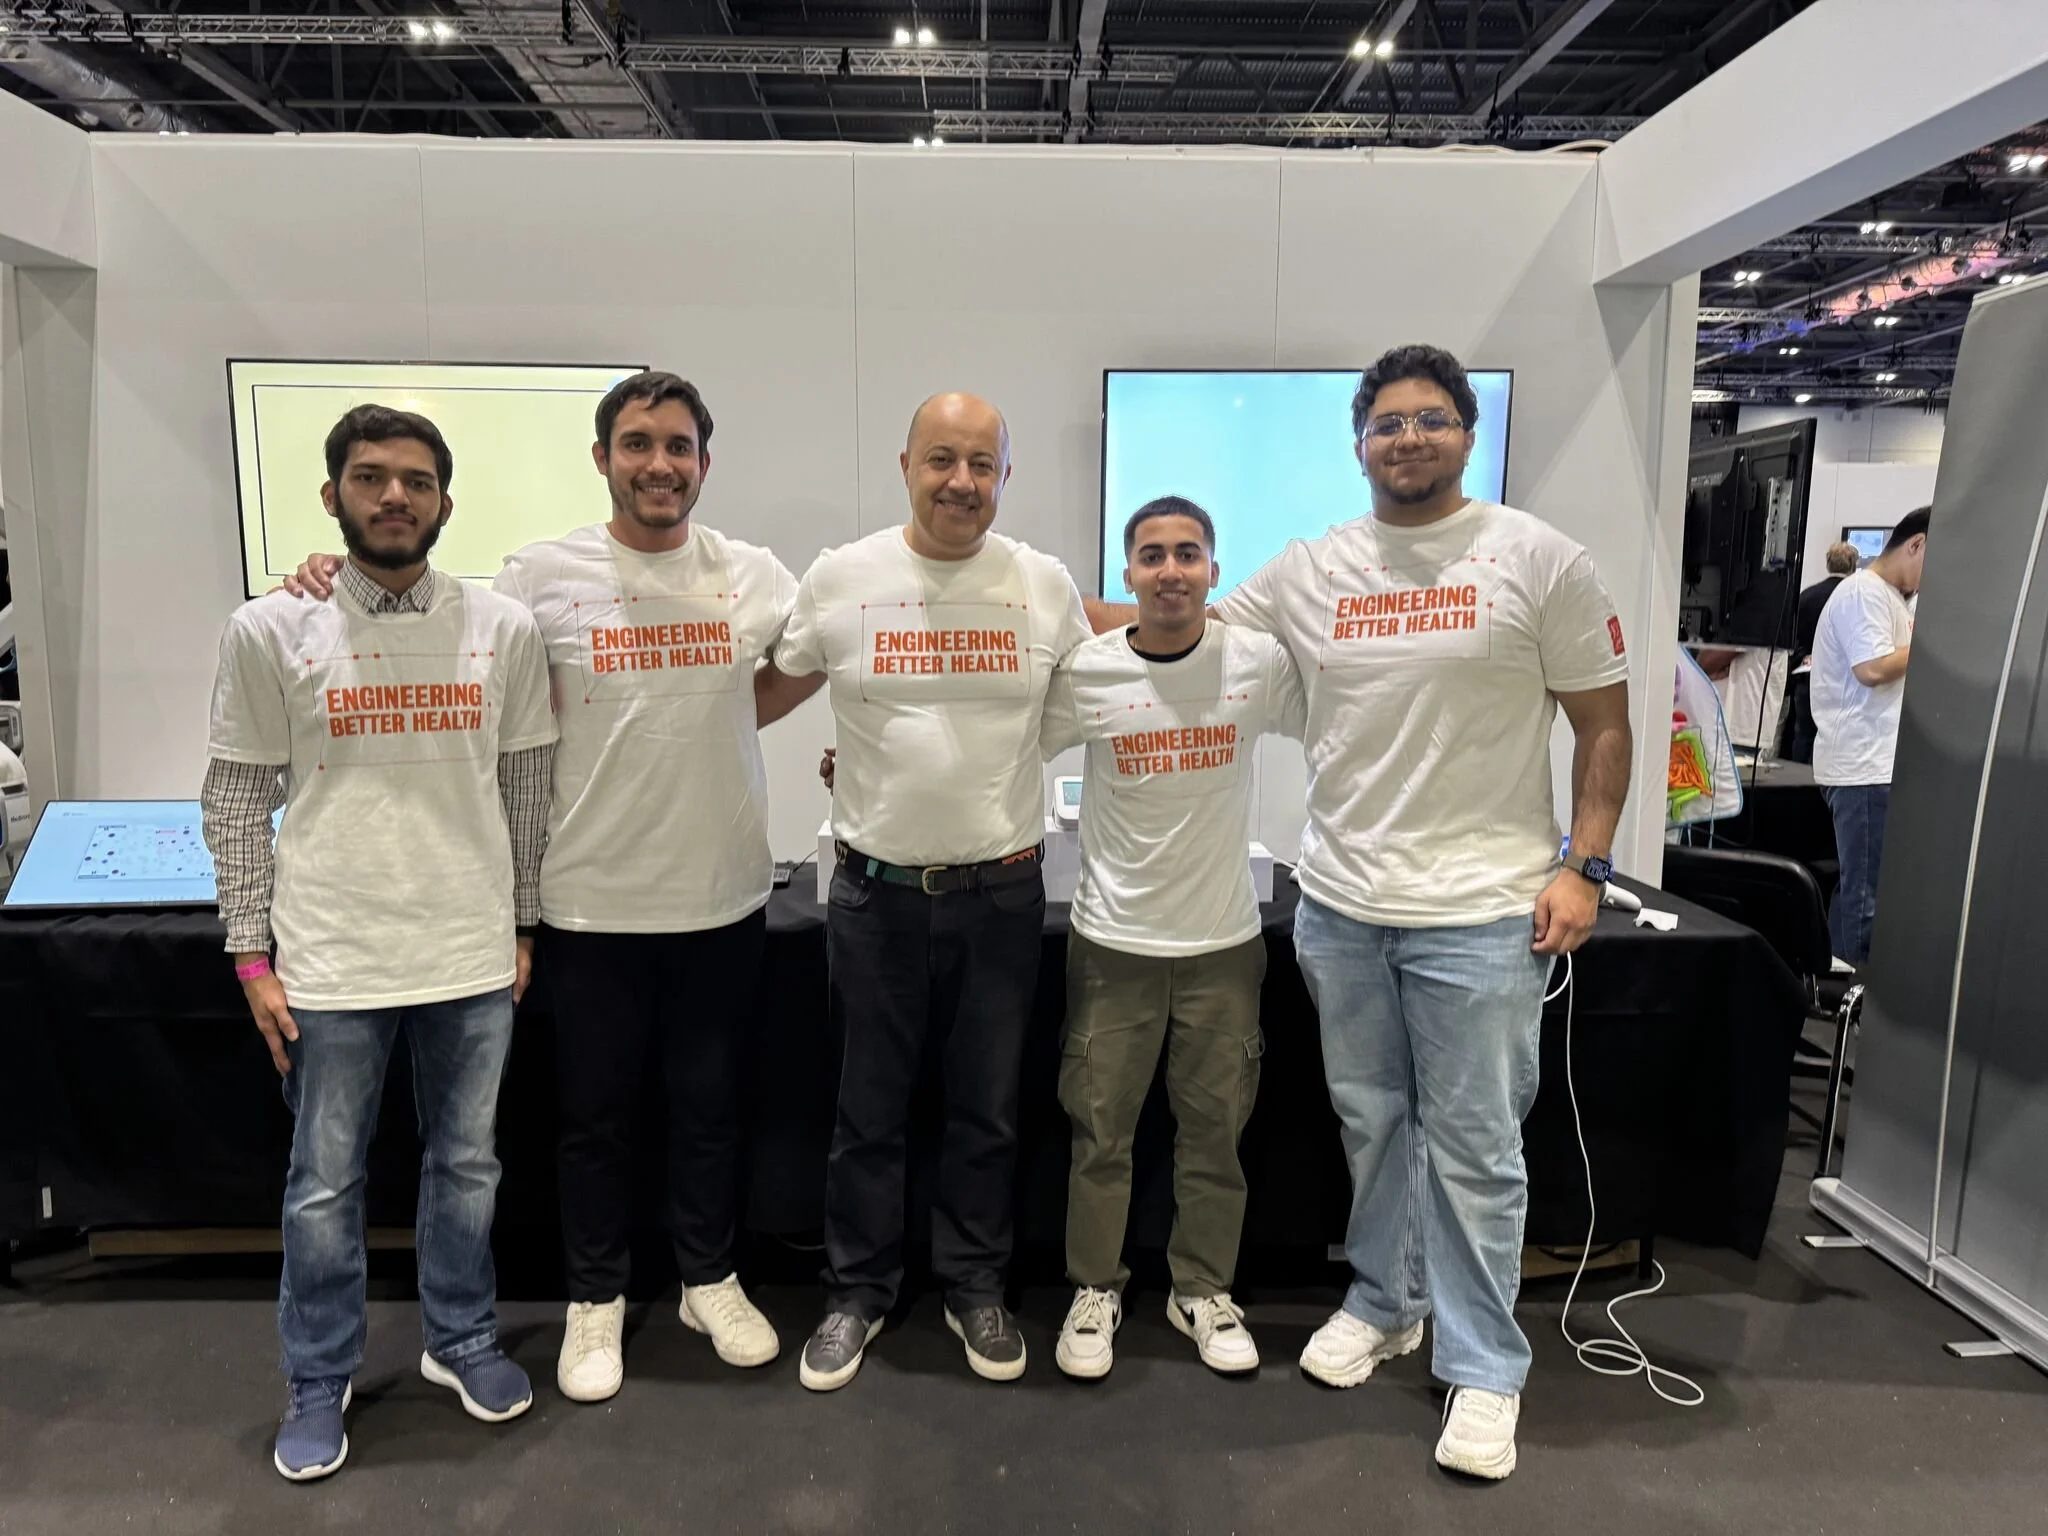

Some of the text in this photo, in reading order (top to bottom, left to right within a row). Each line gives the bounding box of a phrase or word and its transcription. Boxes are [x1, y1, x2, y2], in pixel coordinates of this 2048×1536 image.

[1336, 584, 1477, 618] ENGINEERING
[592, 622, 731, 650] ENGINEERING
[1333, 610, 1476, 640] BETTER HEALTH
[875, 630, 1017, 653] ENGINEERING
[593, 646, 734, 673] BETTER HEALTH
[873, 654, 1019, 674] BETTER HEALTH
[327, 683, 482, 713] ENGINEERING
[329, 710, 482, 738] BETTER HEALTH
[1111, 724, 1237, 755] ENGINEERING
[1116, 746, 1234, 776] BETTER HEALTH
